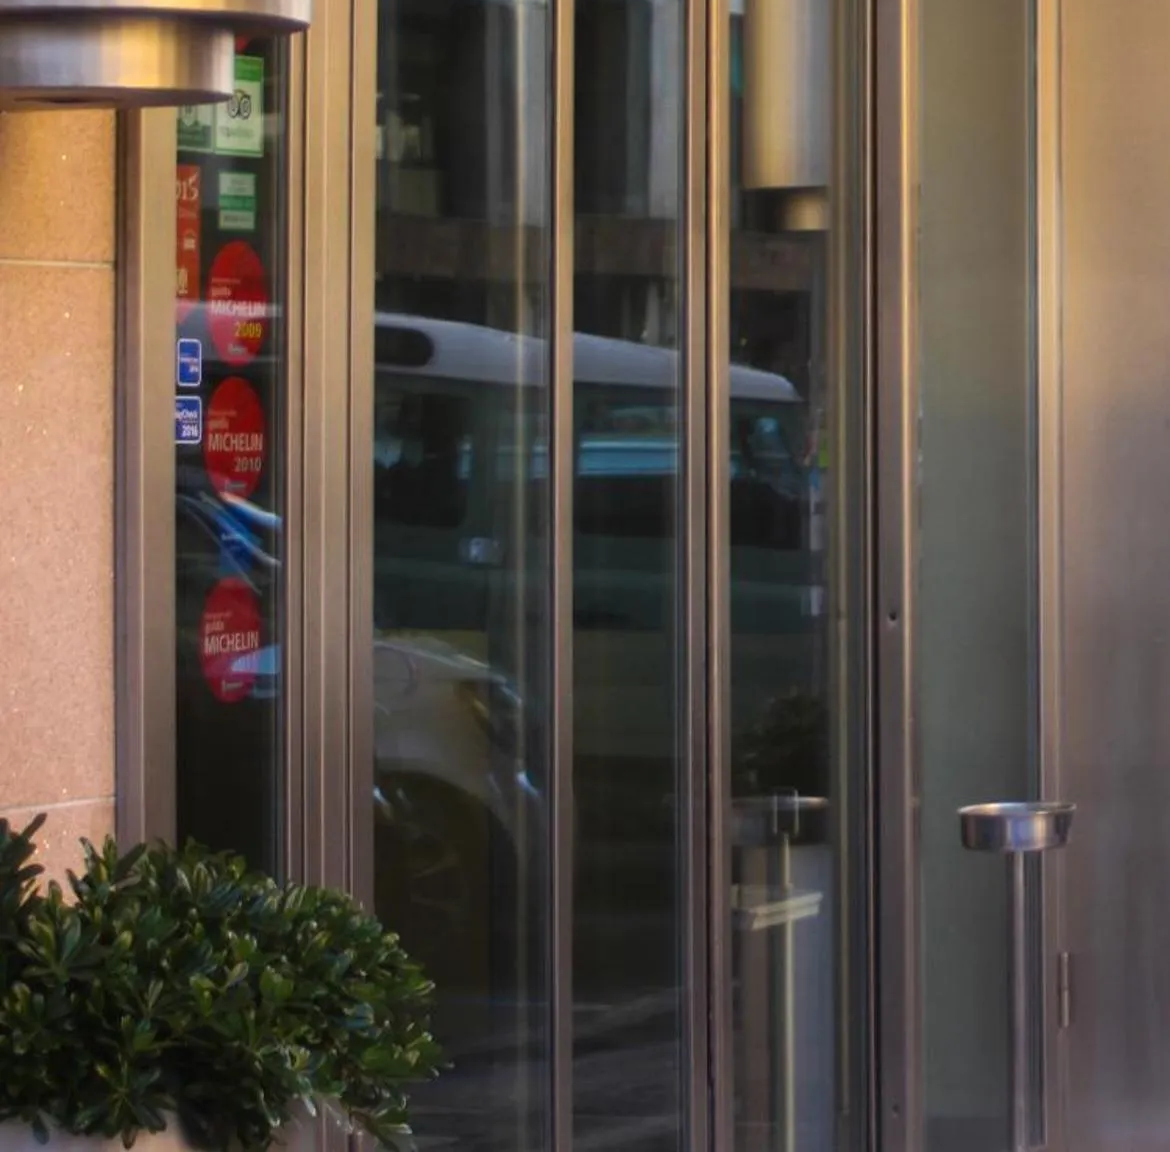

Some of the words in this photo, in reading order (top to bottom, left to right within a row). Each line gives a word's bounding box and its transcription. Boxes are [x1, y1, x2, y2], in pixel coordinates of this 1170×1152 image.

[211, 298, 266, 317] MICHELIN
[208, 432, 264, 452] MICHELIN
[233, 456, 262, 473] 2010
[204, 631, 259, 655] MICHELIN
